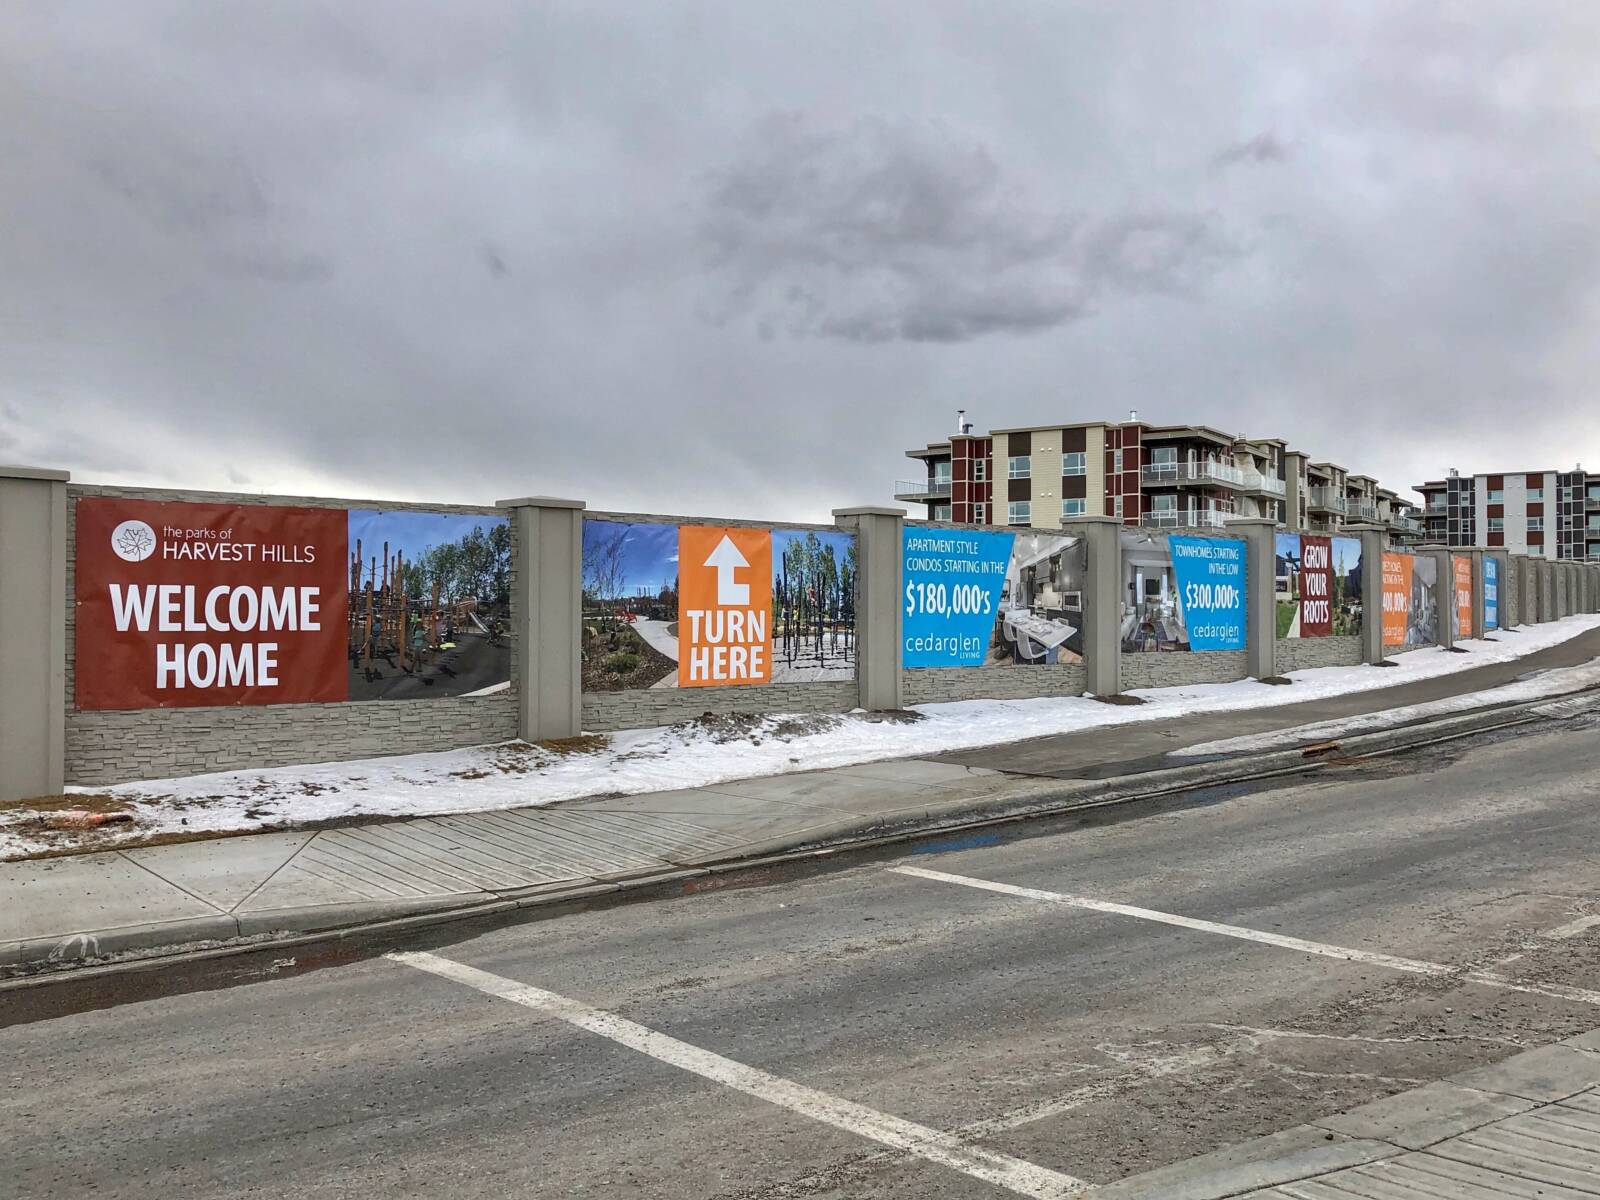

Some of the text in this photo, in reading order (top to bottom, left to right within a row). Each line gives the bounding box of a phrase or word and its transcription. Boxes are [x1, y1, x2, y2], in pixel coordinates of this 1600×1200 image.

[163, 526, 232, 541] the parks of
[163, 542, 316, 564] HARVEST HILLS
[907, 538, 978, 554] APARTMENT STYLE
[1175, 544, 1239, 560] TOWNHOMES STARTING
[1304, 545, 1328, 568] GROW
[906, 558, 1004, 574] CONDOS STARTING IN THE
[1208, 563, 1239, 576] IN THE LOW
[1305, 573, 1327, 596] YOUR
[109, 583, 321, 632] WELCOME
[1304, 600, 1328, 624] ROOTS
[686, 610, 765, 644] TURN
[1193, 623, 1239, 641] cedarglen
[906, 633, 980, 656] cedarglen
[156, 642, 279, 689] HOME
[690, 646, 764, 680] HERE
